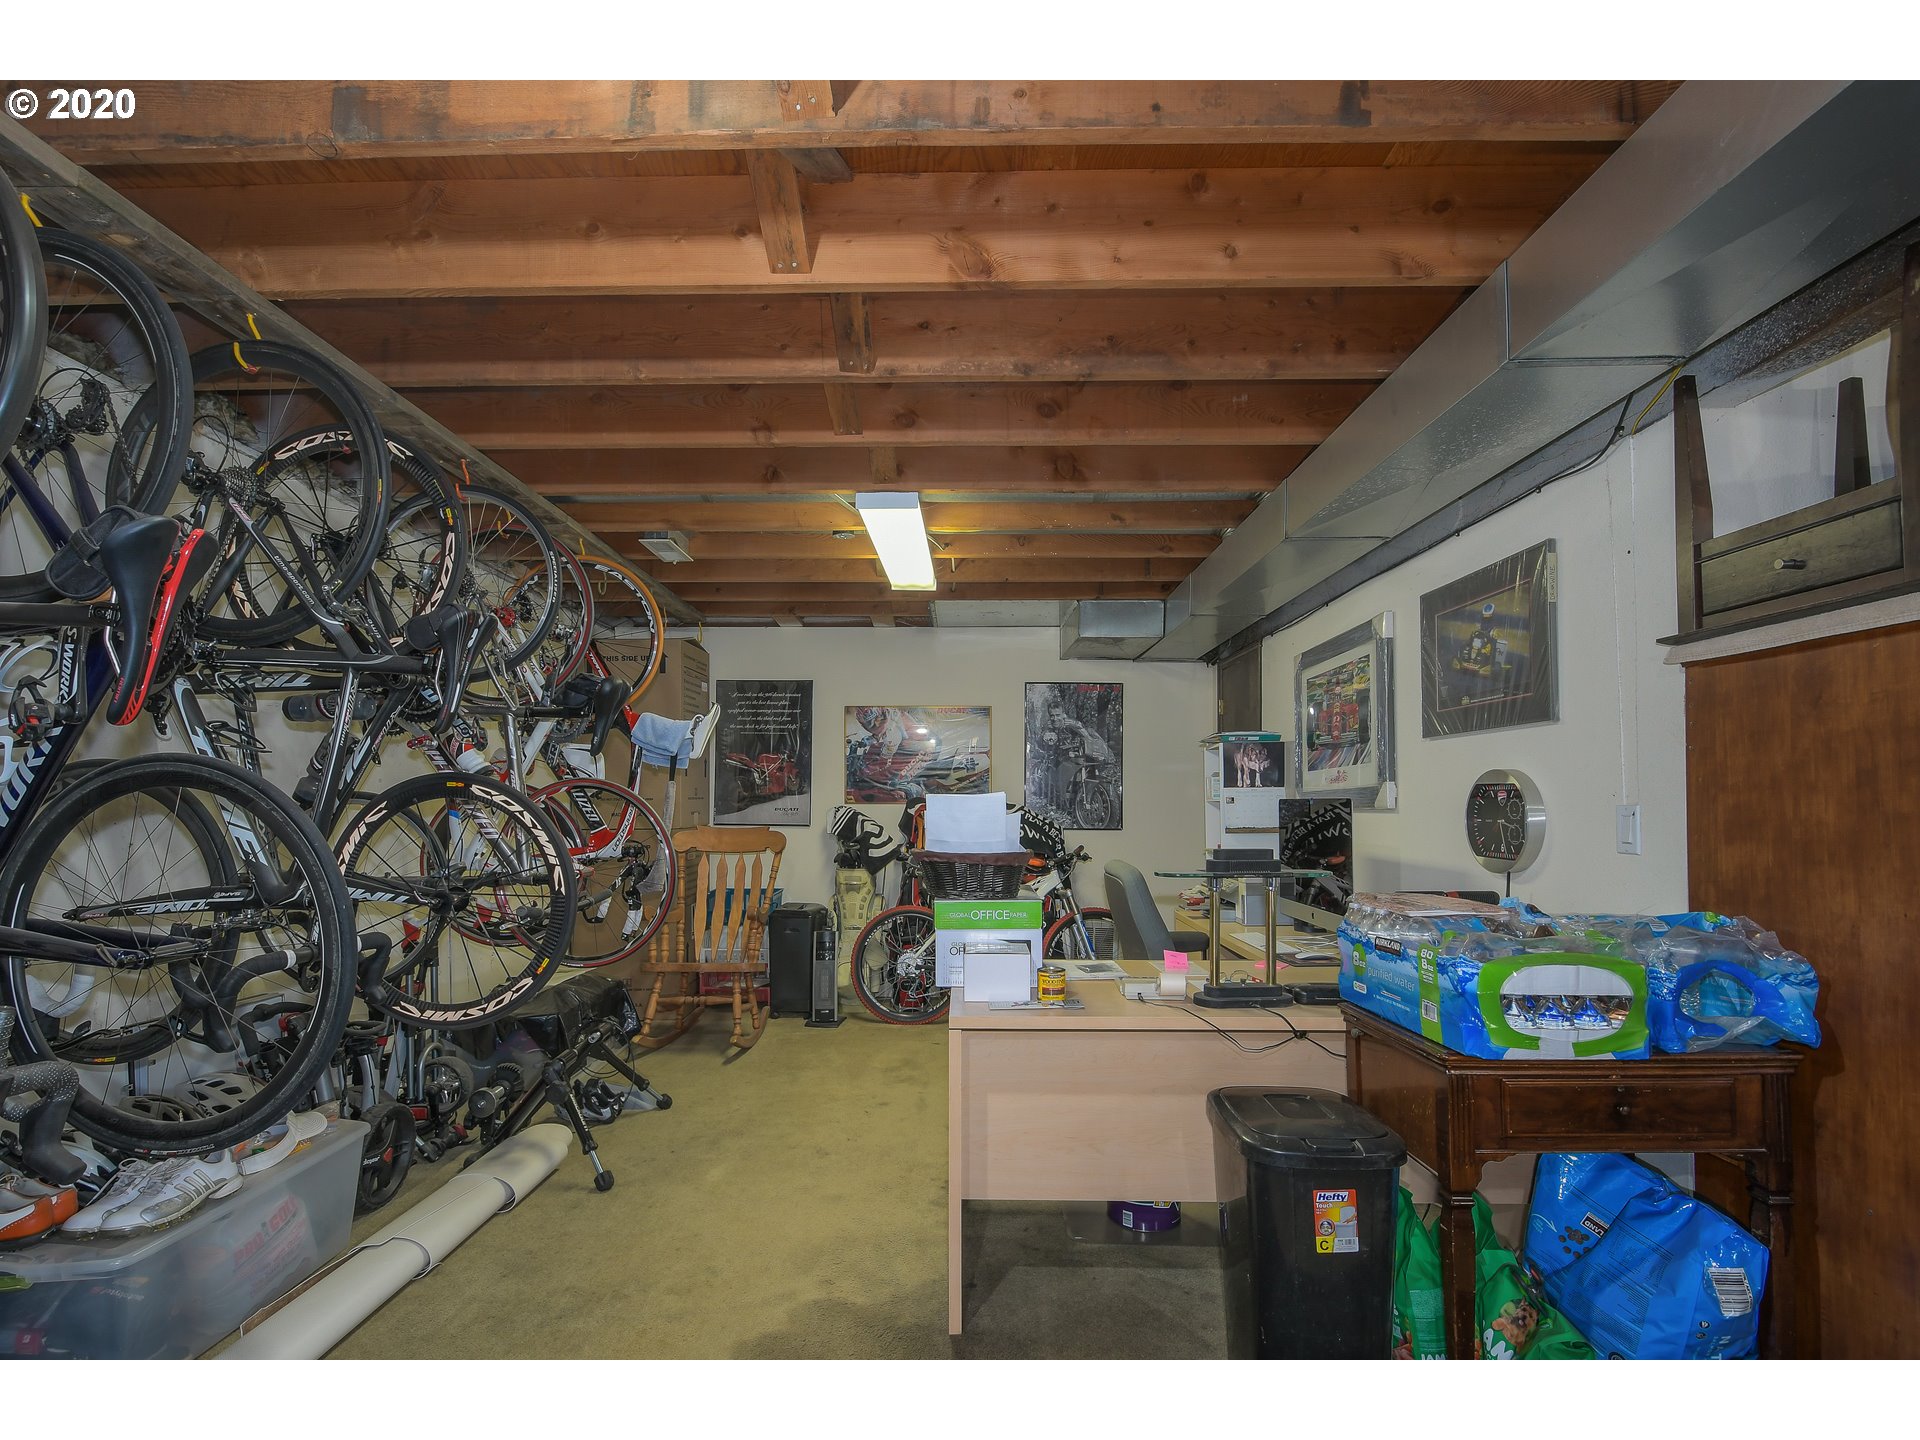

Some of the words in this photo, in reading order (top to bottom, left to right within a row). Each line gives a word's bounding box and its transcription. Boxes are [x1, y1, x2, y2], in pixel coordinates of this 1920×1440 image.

[594, 563, 656, 634] EASTON
[468, 783, 567, 896] COSMIC
[1500, 843, 1506, 853] 6
[347, 887, 409, 904] TIM
[136, 898, 210, 915] TIME
[971, 909, 1010, 921] OFFICE
[1376, 937, 1401, 951] KIRKLAND
[1420, 948, 1433, 959] 80
[1367, 965, 1393, 983] purified
[1394, 975, 1415, 992] water
[392, 976, 534, 1021] COSMIC
[1317, 1193, 1347, 1202] Hefty
[1582, 1218, 1607, 1237] LAND
[1319, 1240, 1329, 1251] C
